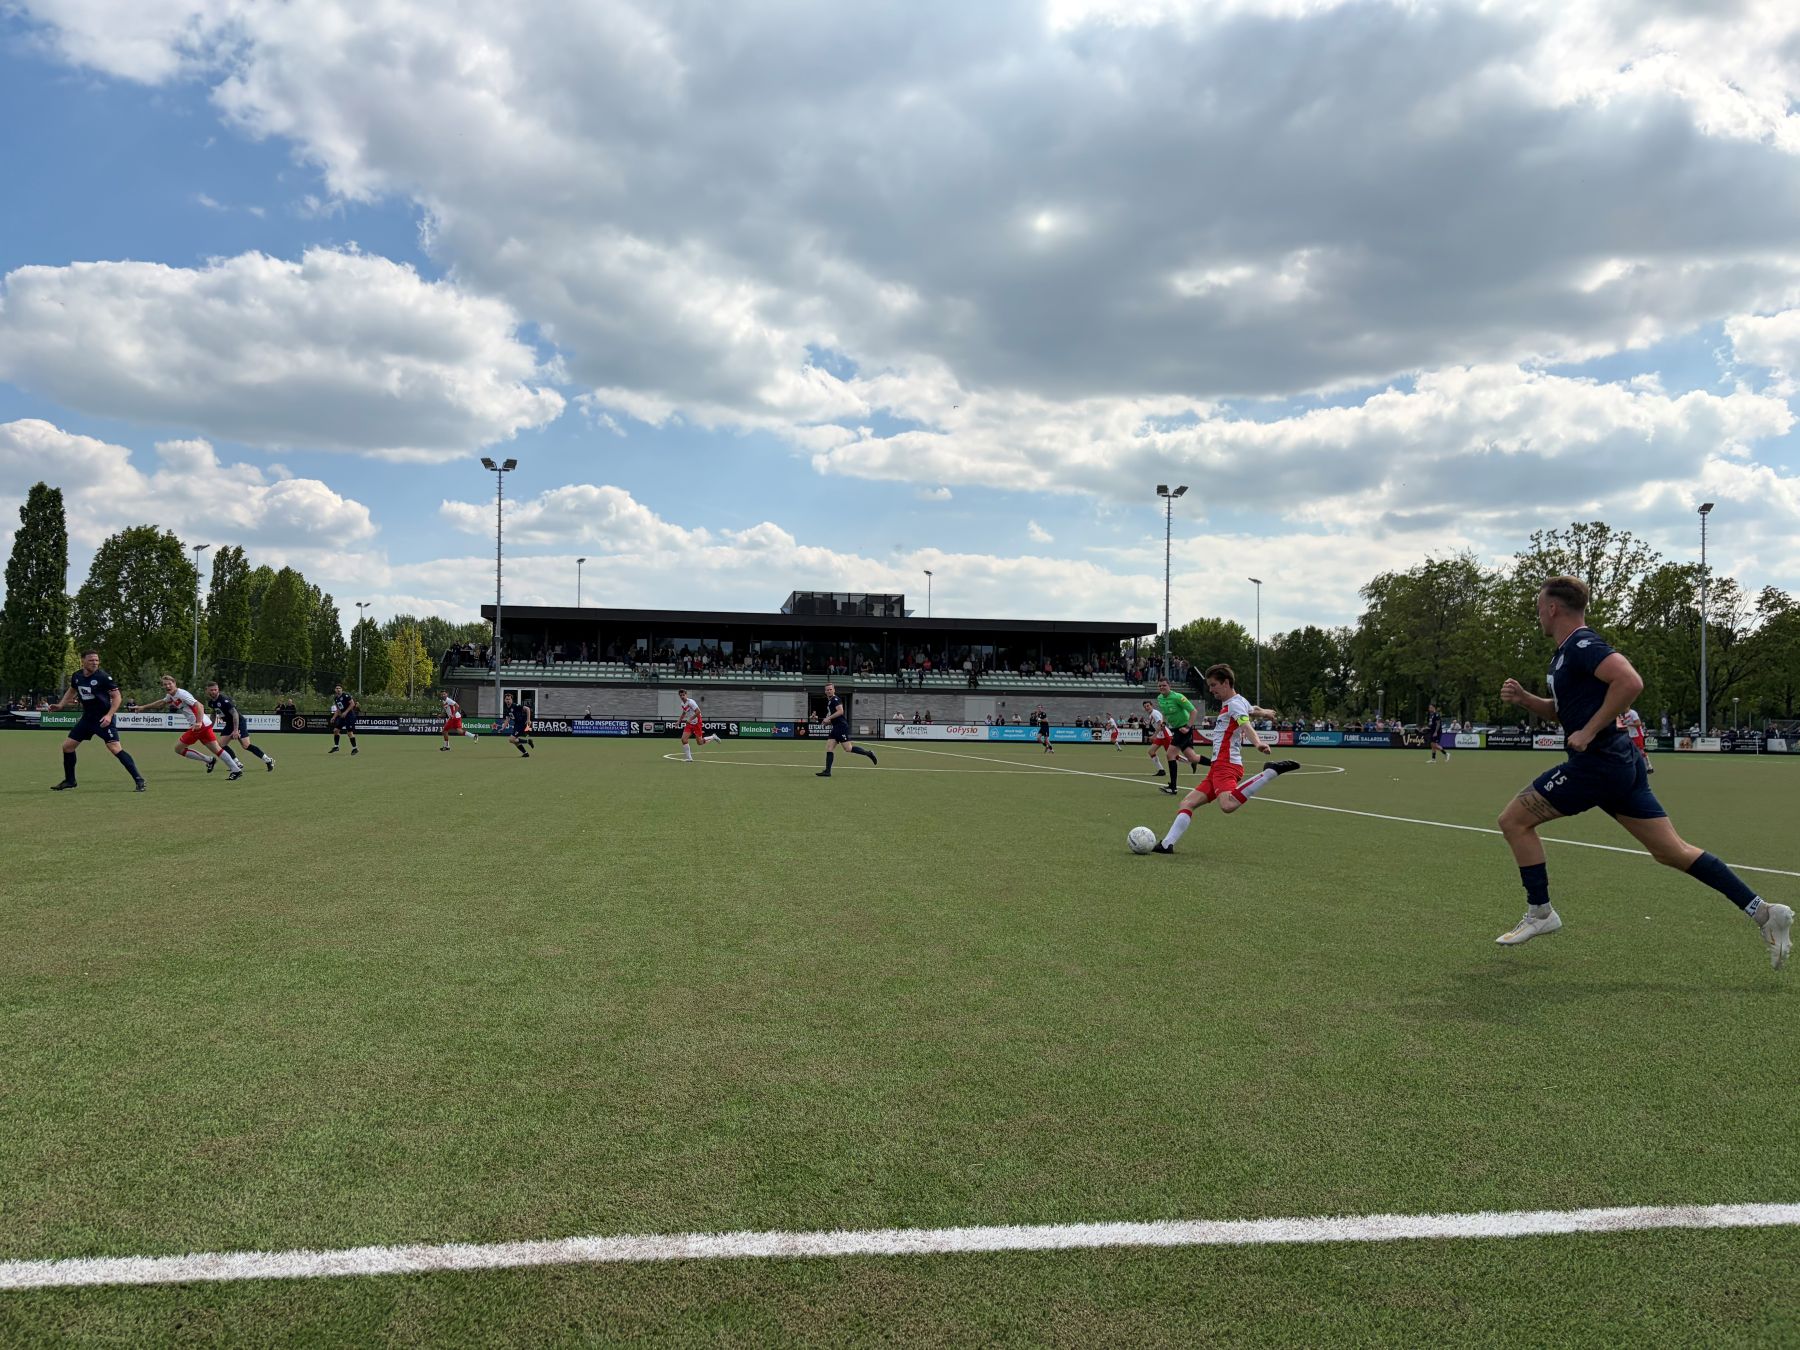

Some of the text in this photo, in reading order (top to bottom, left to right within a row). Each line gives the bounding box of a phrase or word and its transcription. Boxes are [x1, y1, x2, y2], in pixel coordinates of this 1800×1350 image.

[142, 715, 162, 723] hijden
[532, 721, 567, 729] EBARO
[1551, 769, 1568, 785] 15
